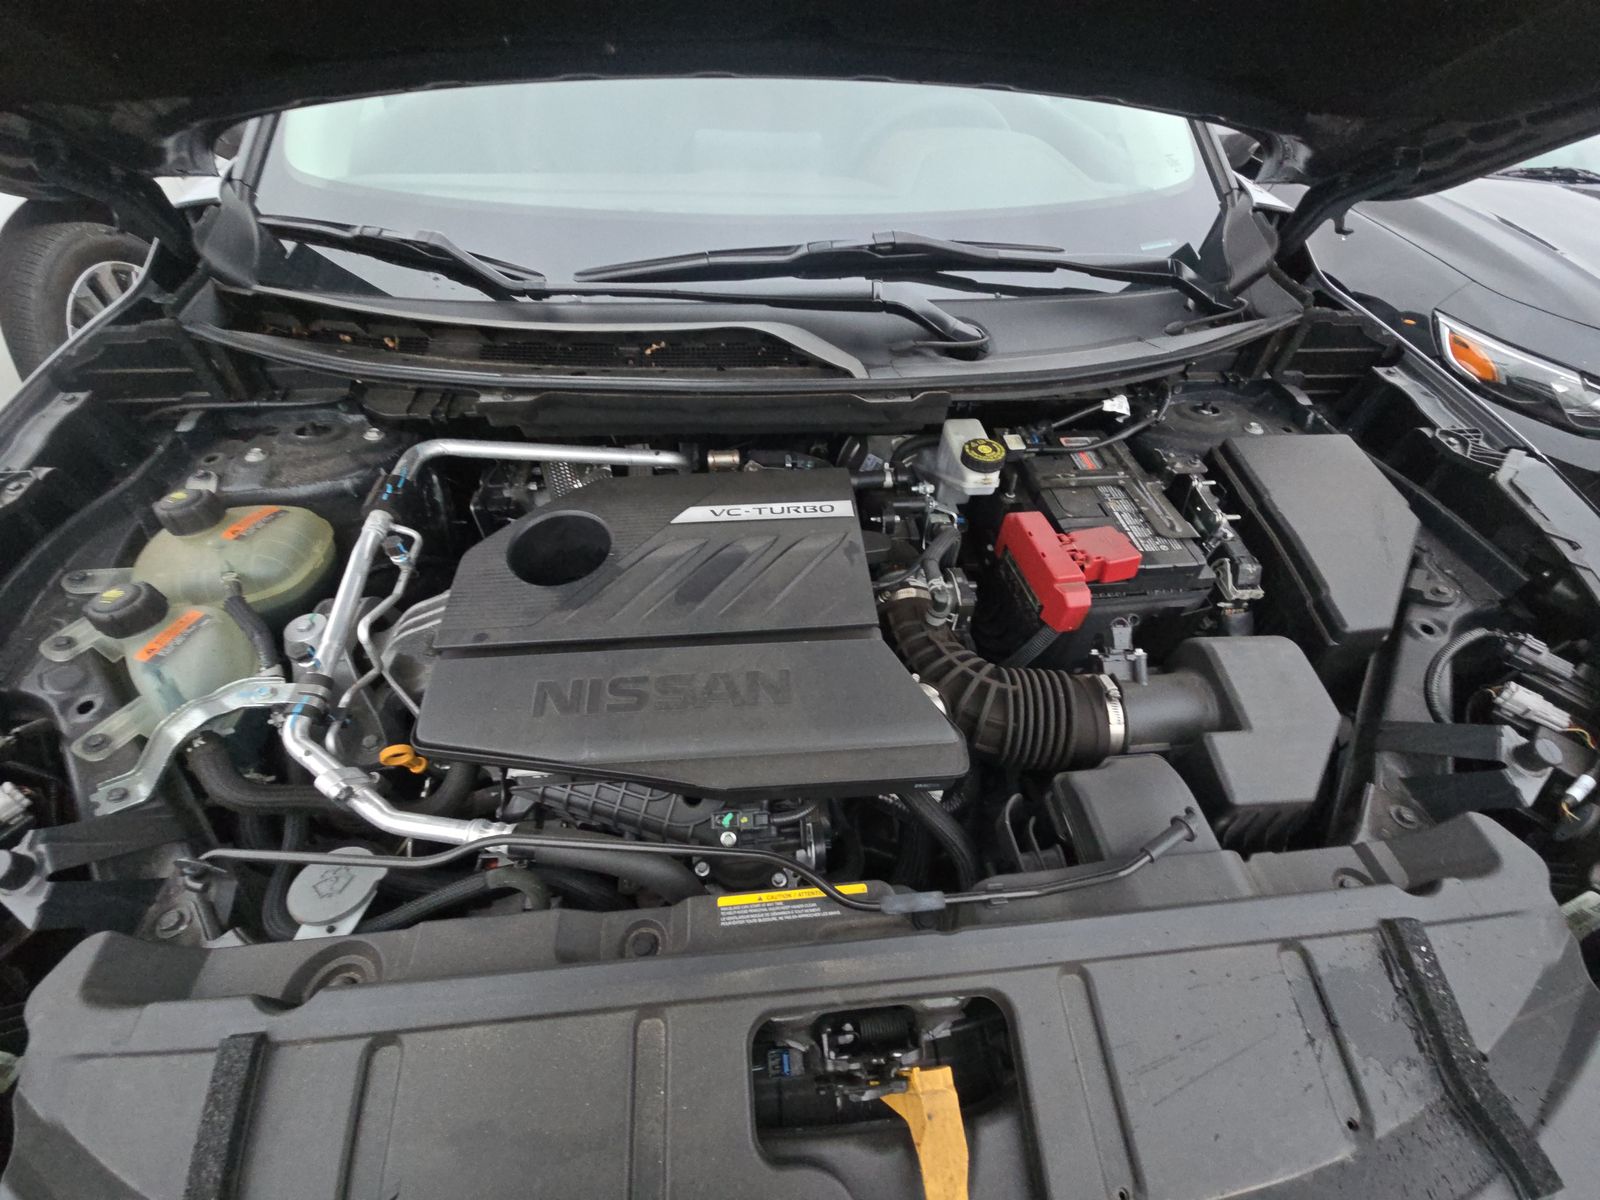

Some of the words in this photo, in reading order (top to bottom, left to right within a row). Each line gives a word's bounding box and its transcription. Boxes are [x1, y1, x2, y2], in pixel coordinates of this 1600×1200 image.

[709, 504, 835, 517] VC-TURBO
[532, 669, 791, 718] NISSAN
[766, 892, 793, 900] CAUTION
